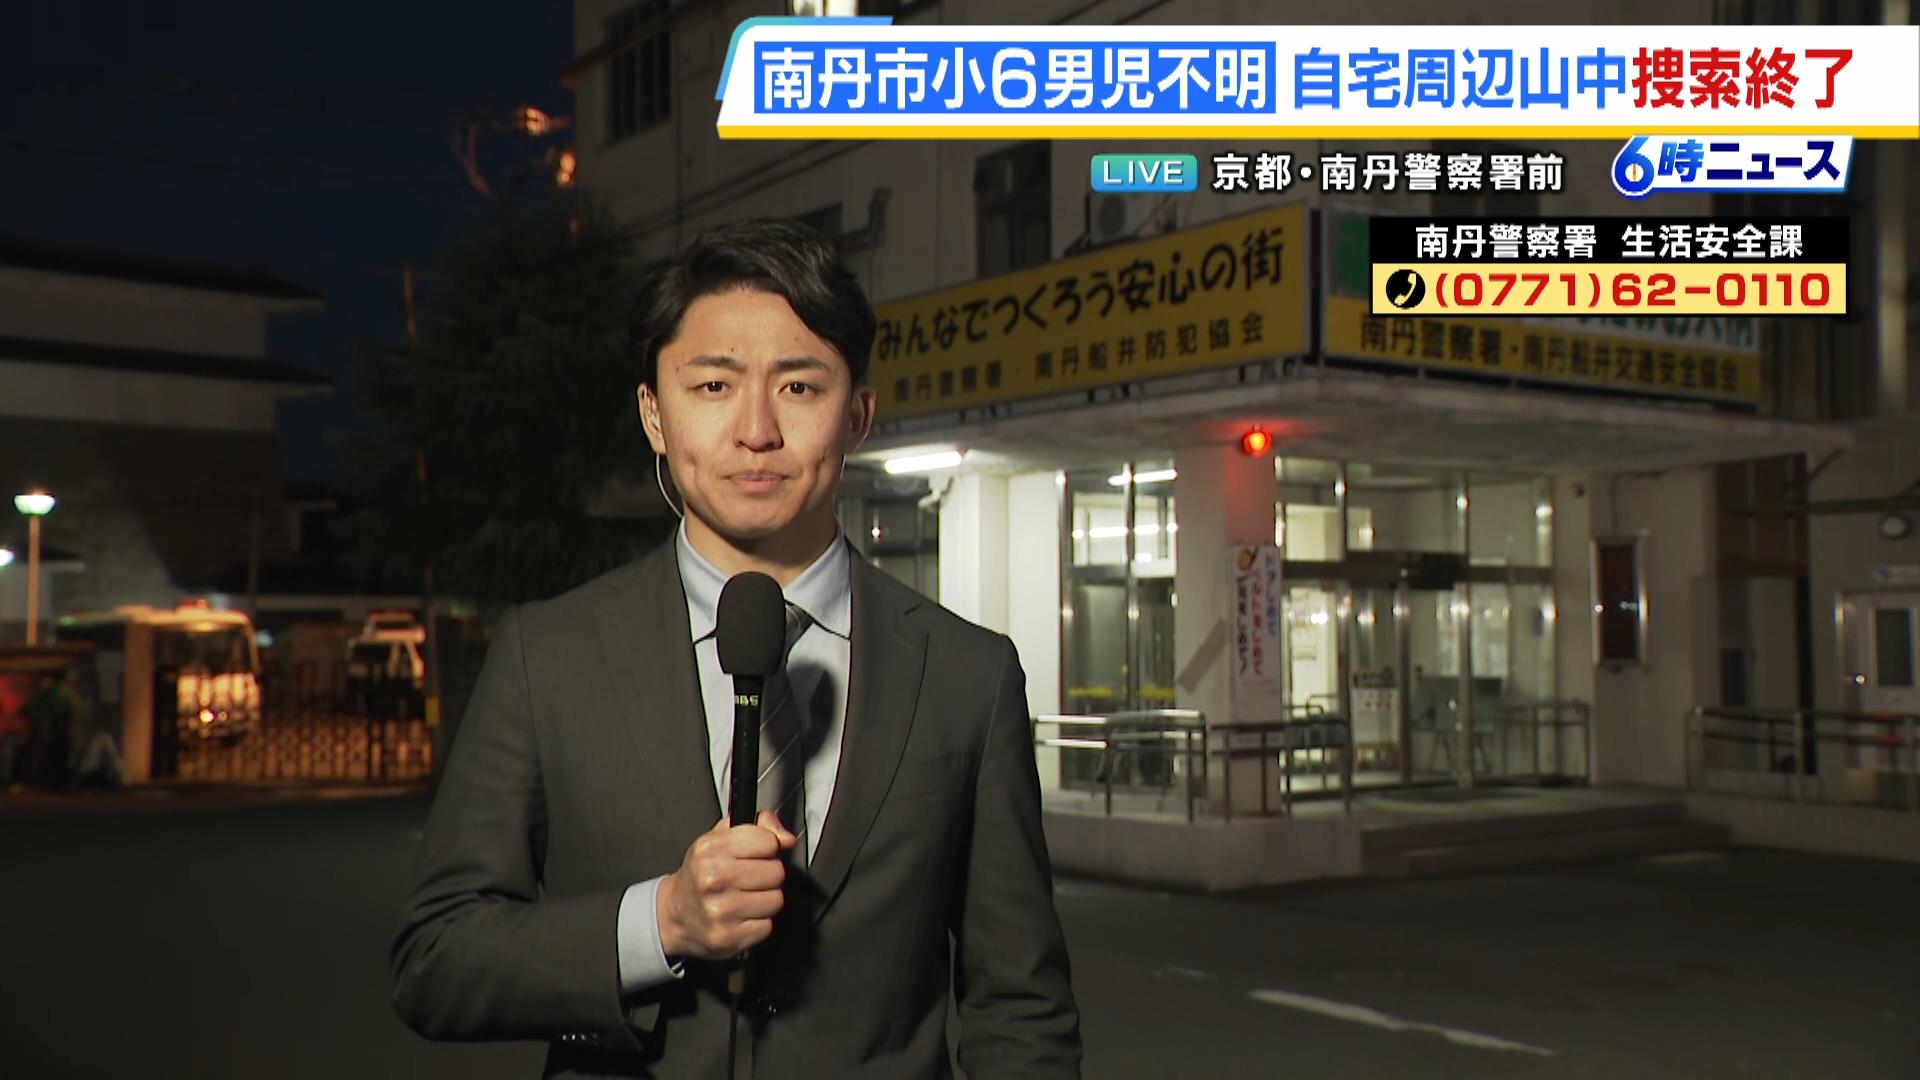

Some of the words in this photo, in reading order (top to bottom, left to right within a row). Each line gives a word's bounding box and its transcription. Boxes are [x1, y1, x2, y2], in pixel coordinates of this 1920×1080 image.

[876, 226, 1283, 362] みんなでつくろう安心の街
